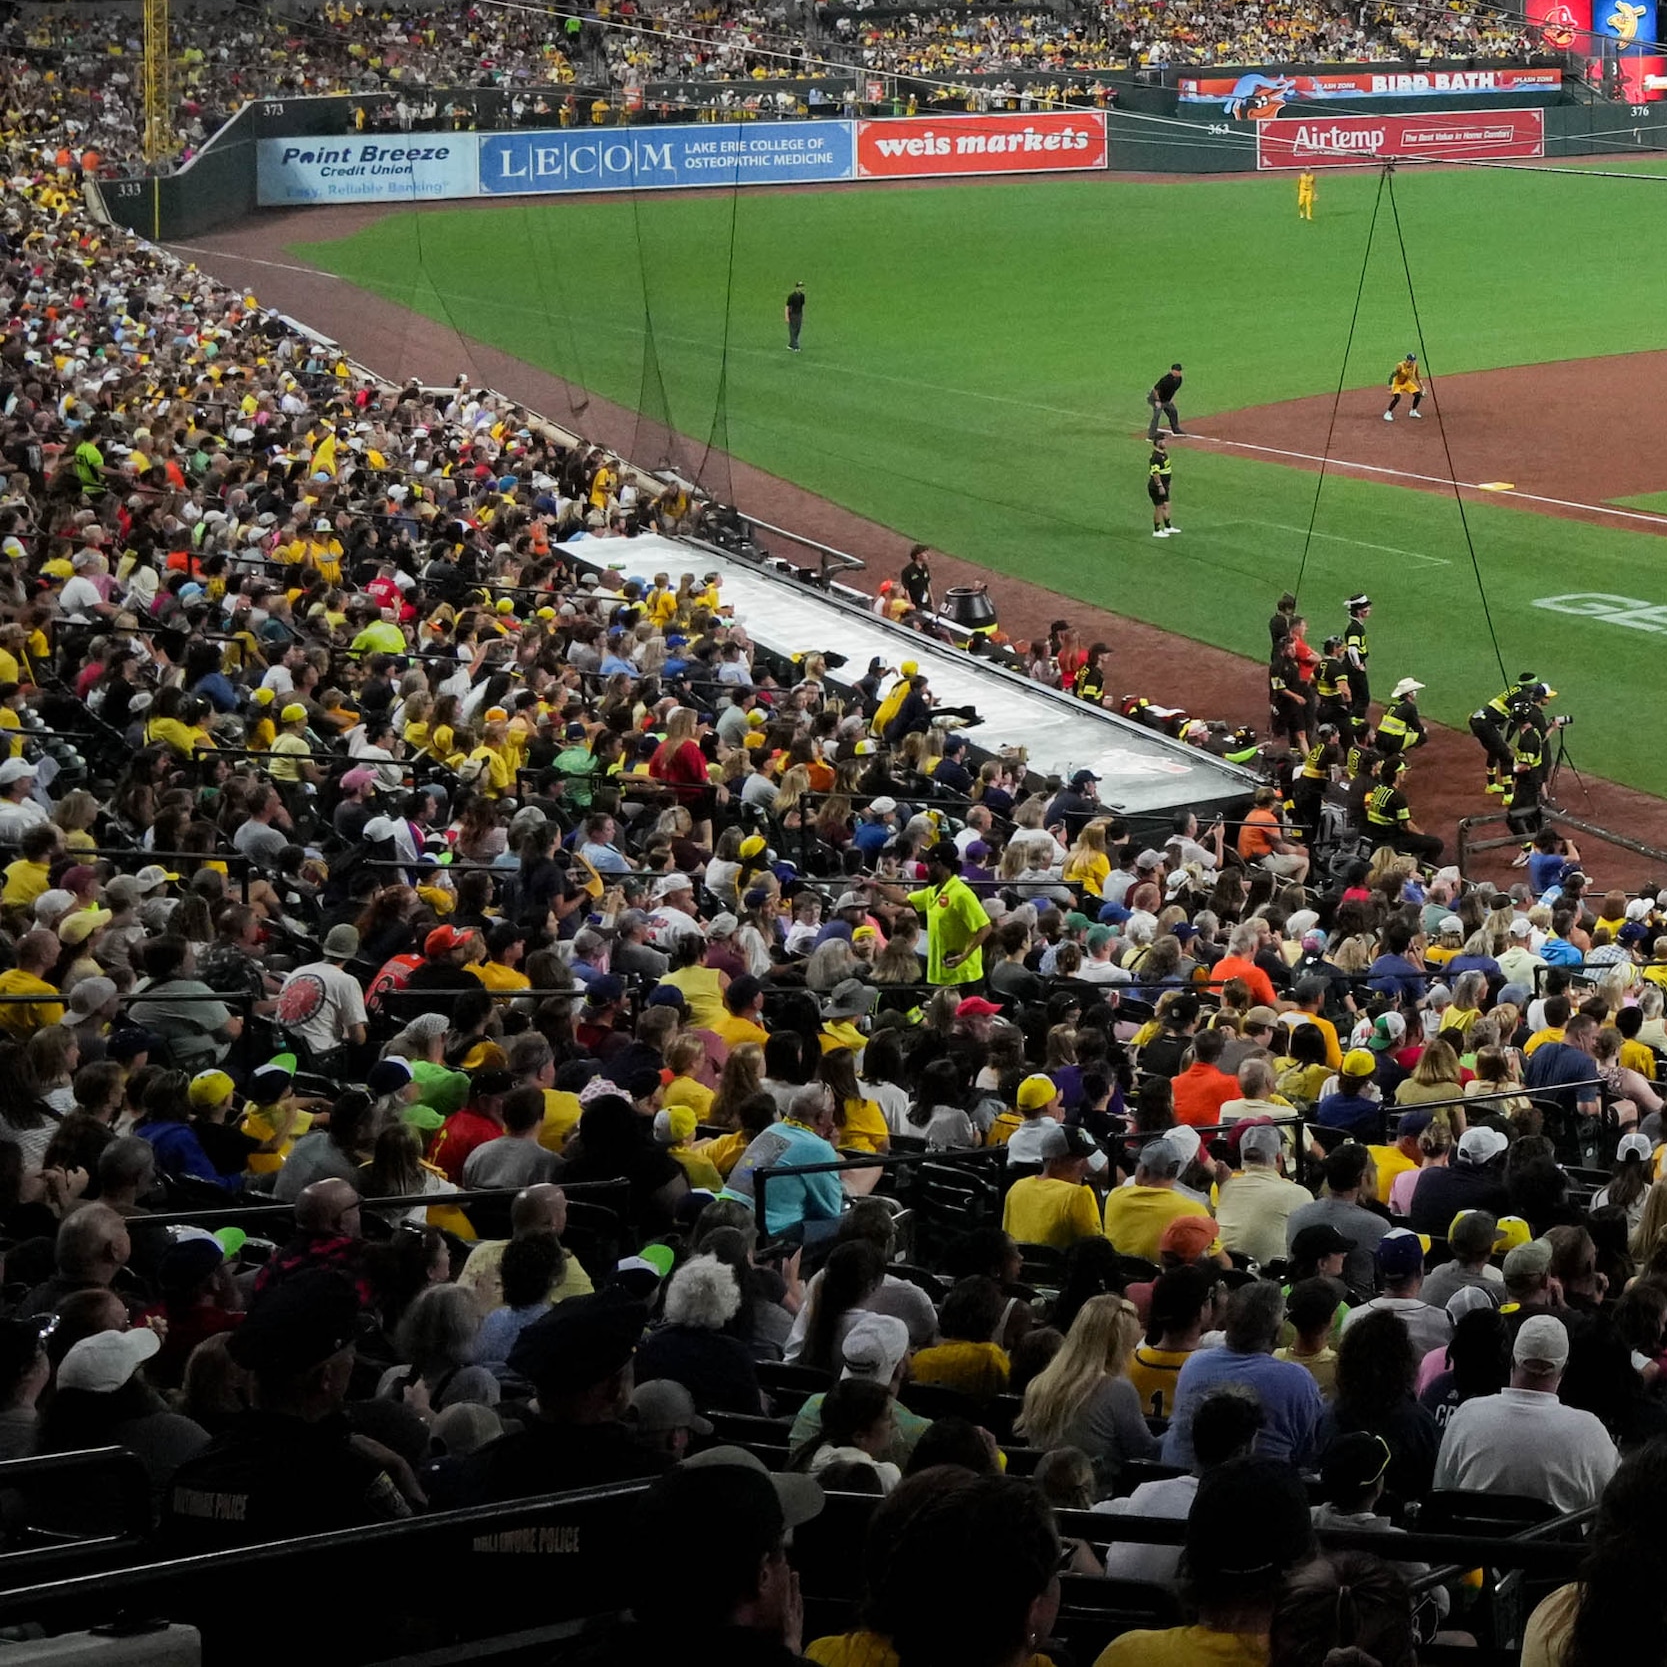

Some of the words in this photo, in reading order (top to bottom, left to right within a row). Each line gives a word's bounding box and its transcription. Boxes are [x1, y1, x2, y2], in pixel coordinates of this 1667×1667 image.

[1336, 81, 1356, 89] ZONE
[1371, 74, 1431, 92] BIRD
[1435, 73, 1501, 90] BATH
[1535, 75, 1554, 83] ZONE
[263, 104, 285, 116] 373
[1631, 107, 1650, 117] 376
[875, 131, 951, 157] weis
[956, 127, 1089, 155] markets
[1295, 126, 1384, 152] Airtemp
[1405, 133, 1417, 142] The
[1483, 129, 1512, 139] Comfort
[685, 142, 717, 153] LAKE
[719, 140, 747, 152] ERIE
[749, 139, 805, 151] COLLEGE
[807, 138, 824, 150] OF
[359, 145, 450, 163] Breeze
[685, 153, 771, 169] OSTEOPATHIC
[774, 151, 834, 165] MEDICINE
[320, 165, 369, 178] Credit
[370, 164, 413, 176] Union
[328, 183, 383, 195] Reliable
[1151, 1390, 1163, 1417] 1
